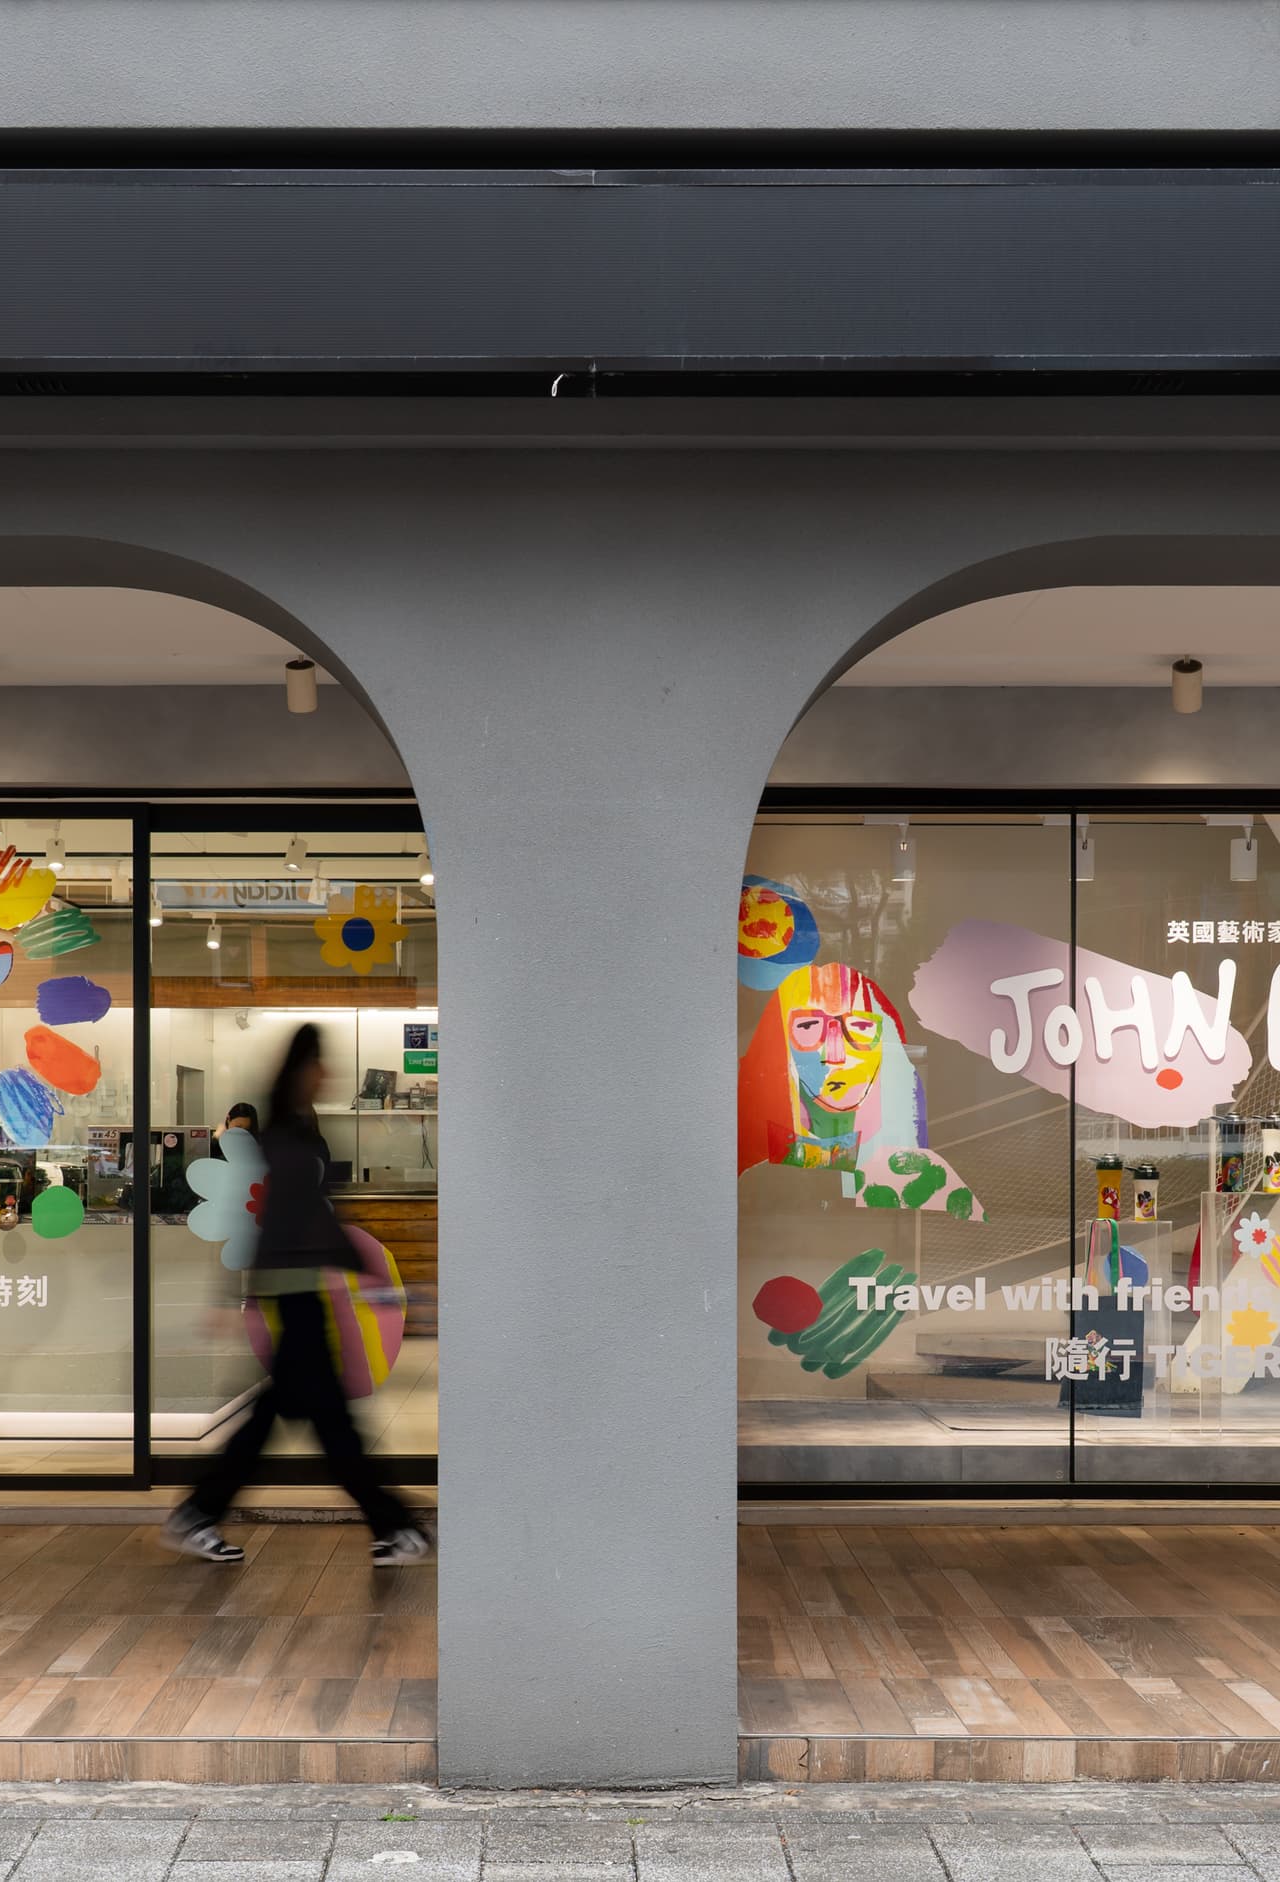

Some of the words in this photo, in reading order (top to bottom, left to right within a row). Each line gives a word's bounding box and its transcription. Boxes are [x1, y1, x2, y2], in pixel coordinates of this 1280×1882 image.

[848, 1276, 987, 1312] Travel
[1001, 1276, 1100, 1312] with
[1045, 1336, 1137, 1382] 隨行
